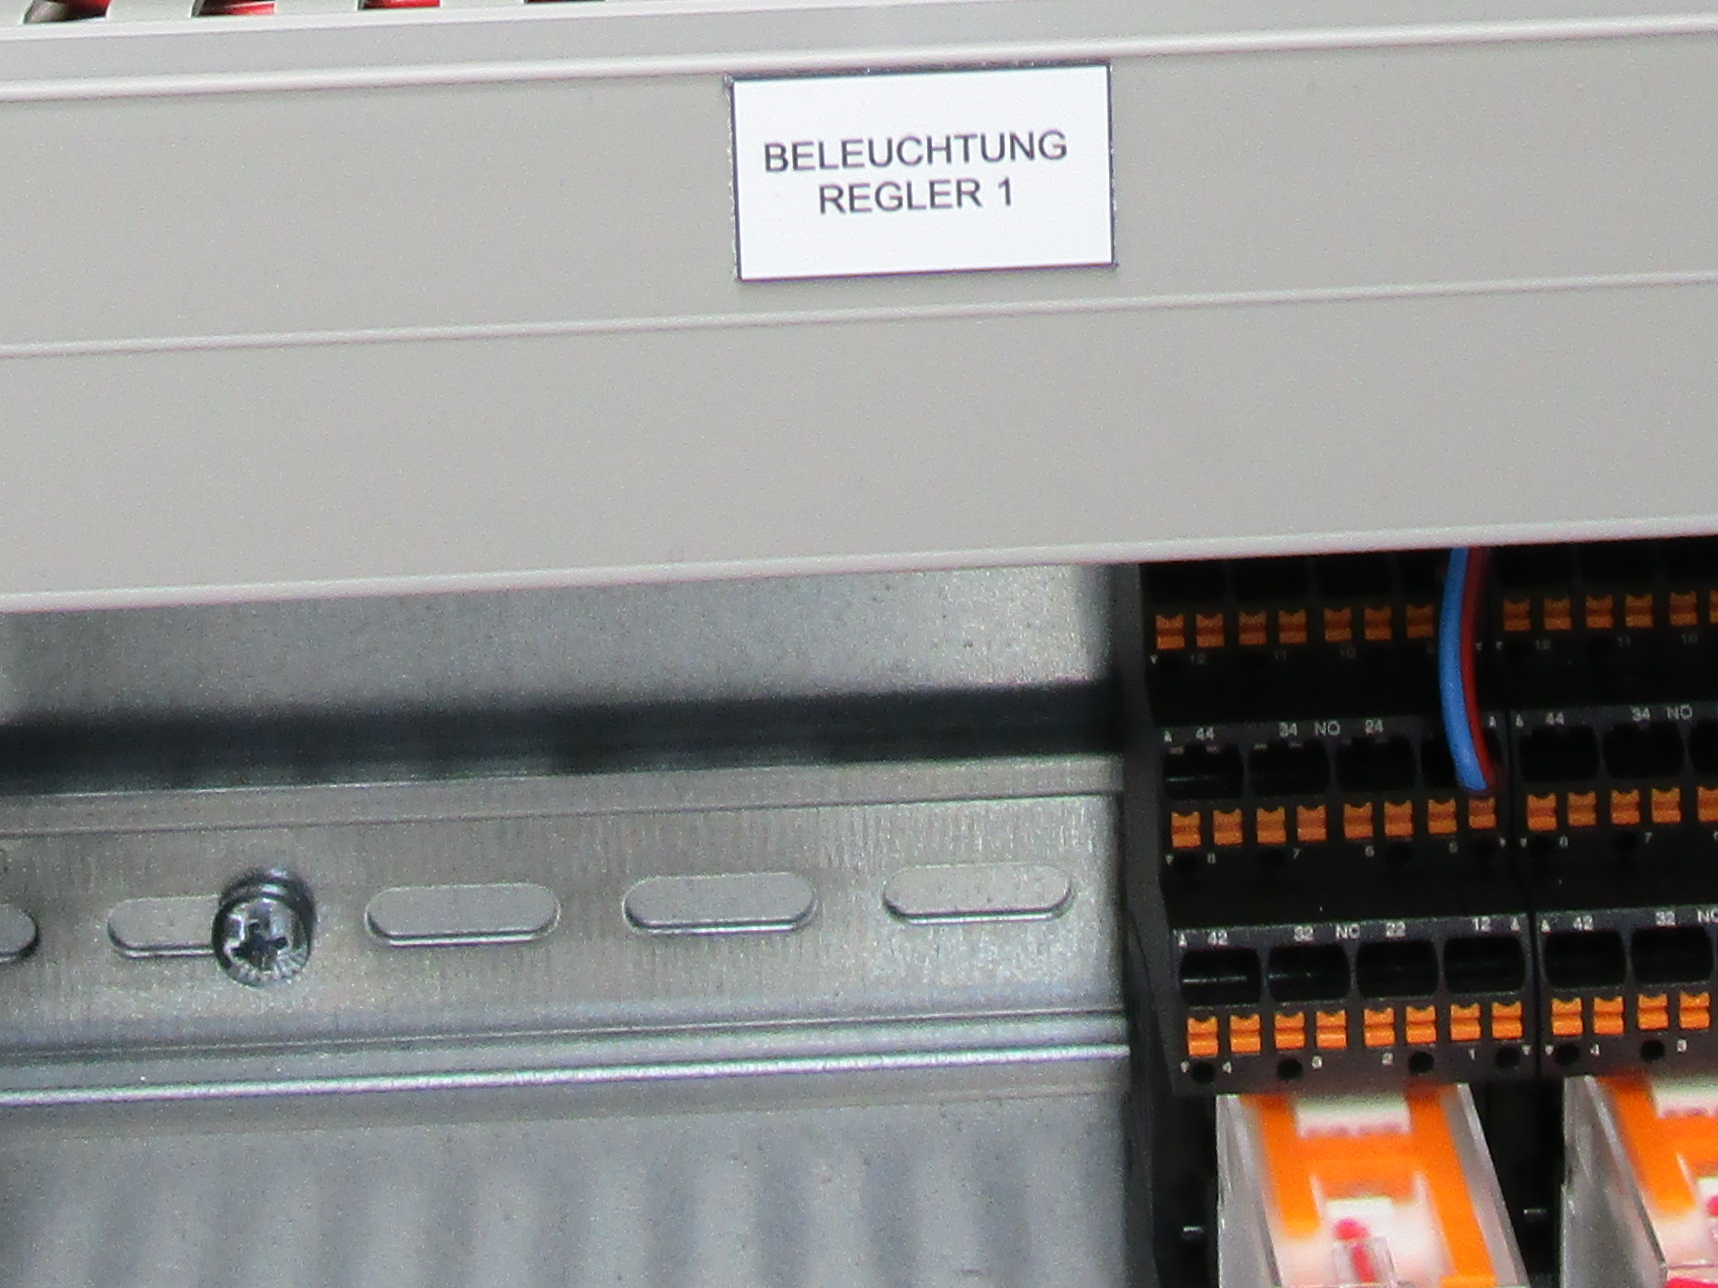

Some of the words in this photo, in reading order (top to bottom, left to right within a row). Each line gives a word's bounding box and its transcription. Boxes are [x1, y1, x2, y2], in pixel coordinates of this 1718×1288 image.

[764, 129, 1068, 173] BELEUCHTUNG
[819, 178, 982, 215] REGLER
[997, 177, 1012, 207] 1
[1335, 925, 1361, 940] NC
